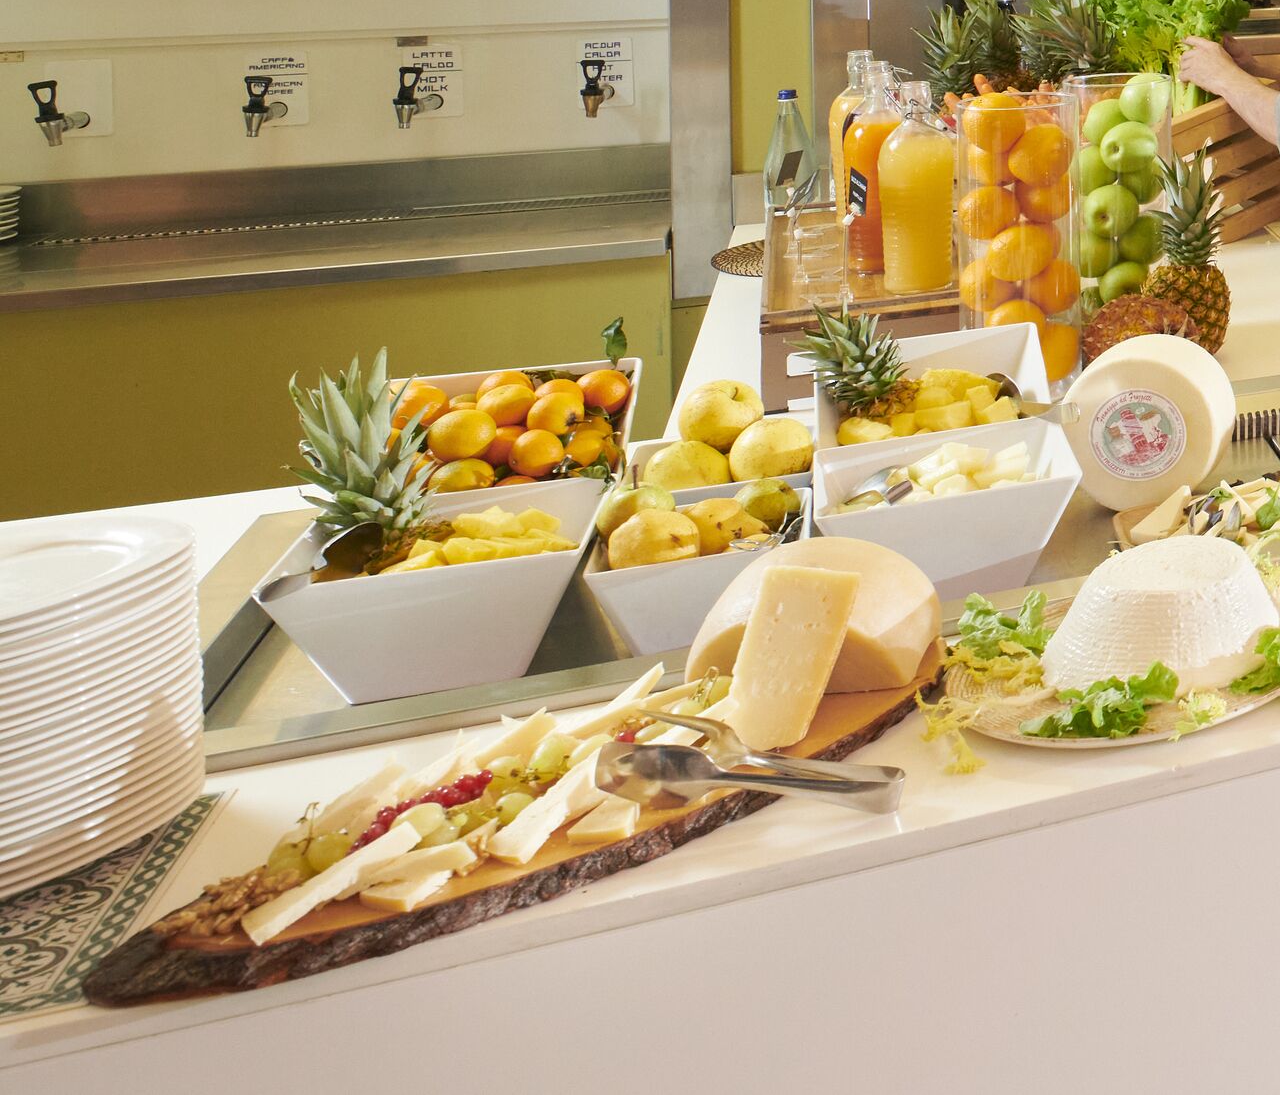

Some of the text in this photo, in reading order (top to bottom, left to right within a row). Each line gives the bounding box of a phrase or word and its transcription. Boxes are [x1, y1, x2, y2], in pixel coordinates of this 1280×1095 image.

[584, 41, 621, 49] ACQUA
[584, 50, 621, 58] CALDA
[248, 63, 305, 71] AMERICANO
[419, 75, 446, 83] HOT
[417, 84, 448, 92] MILK
